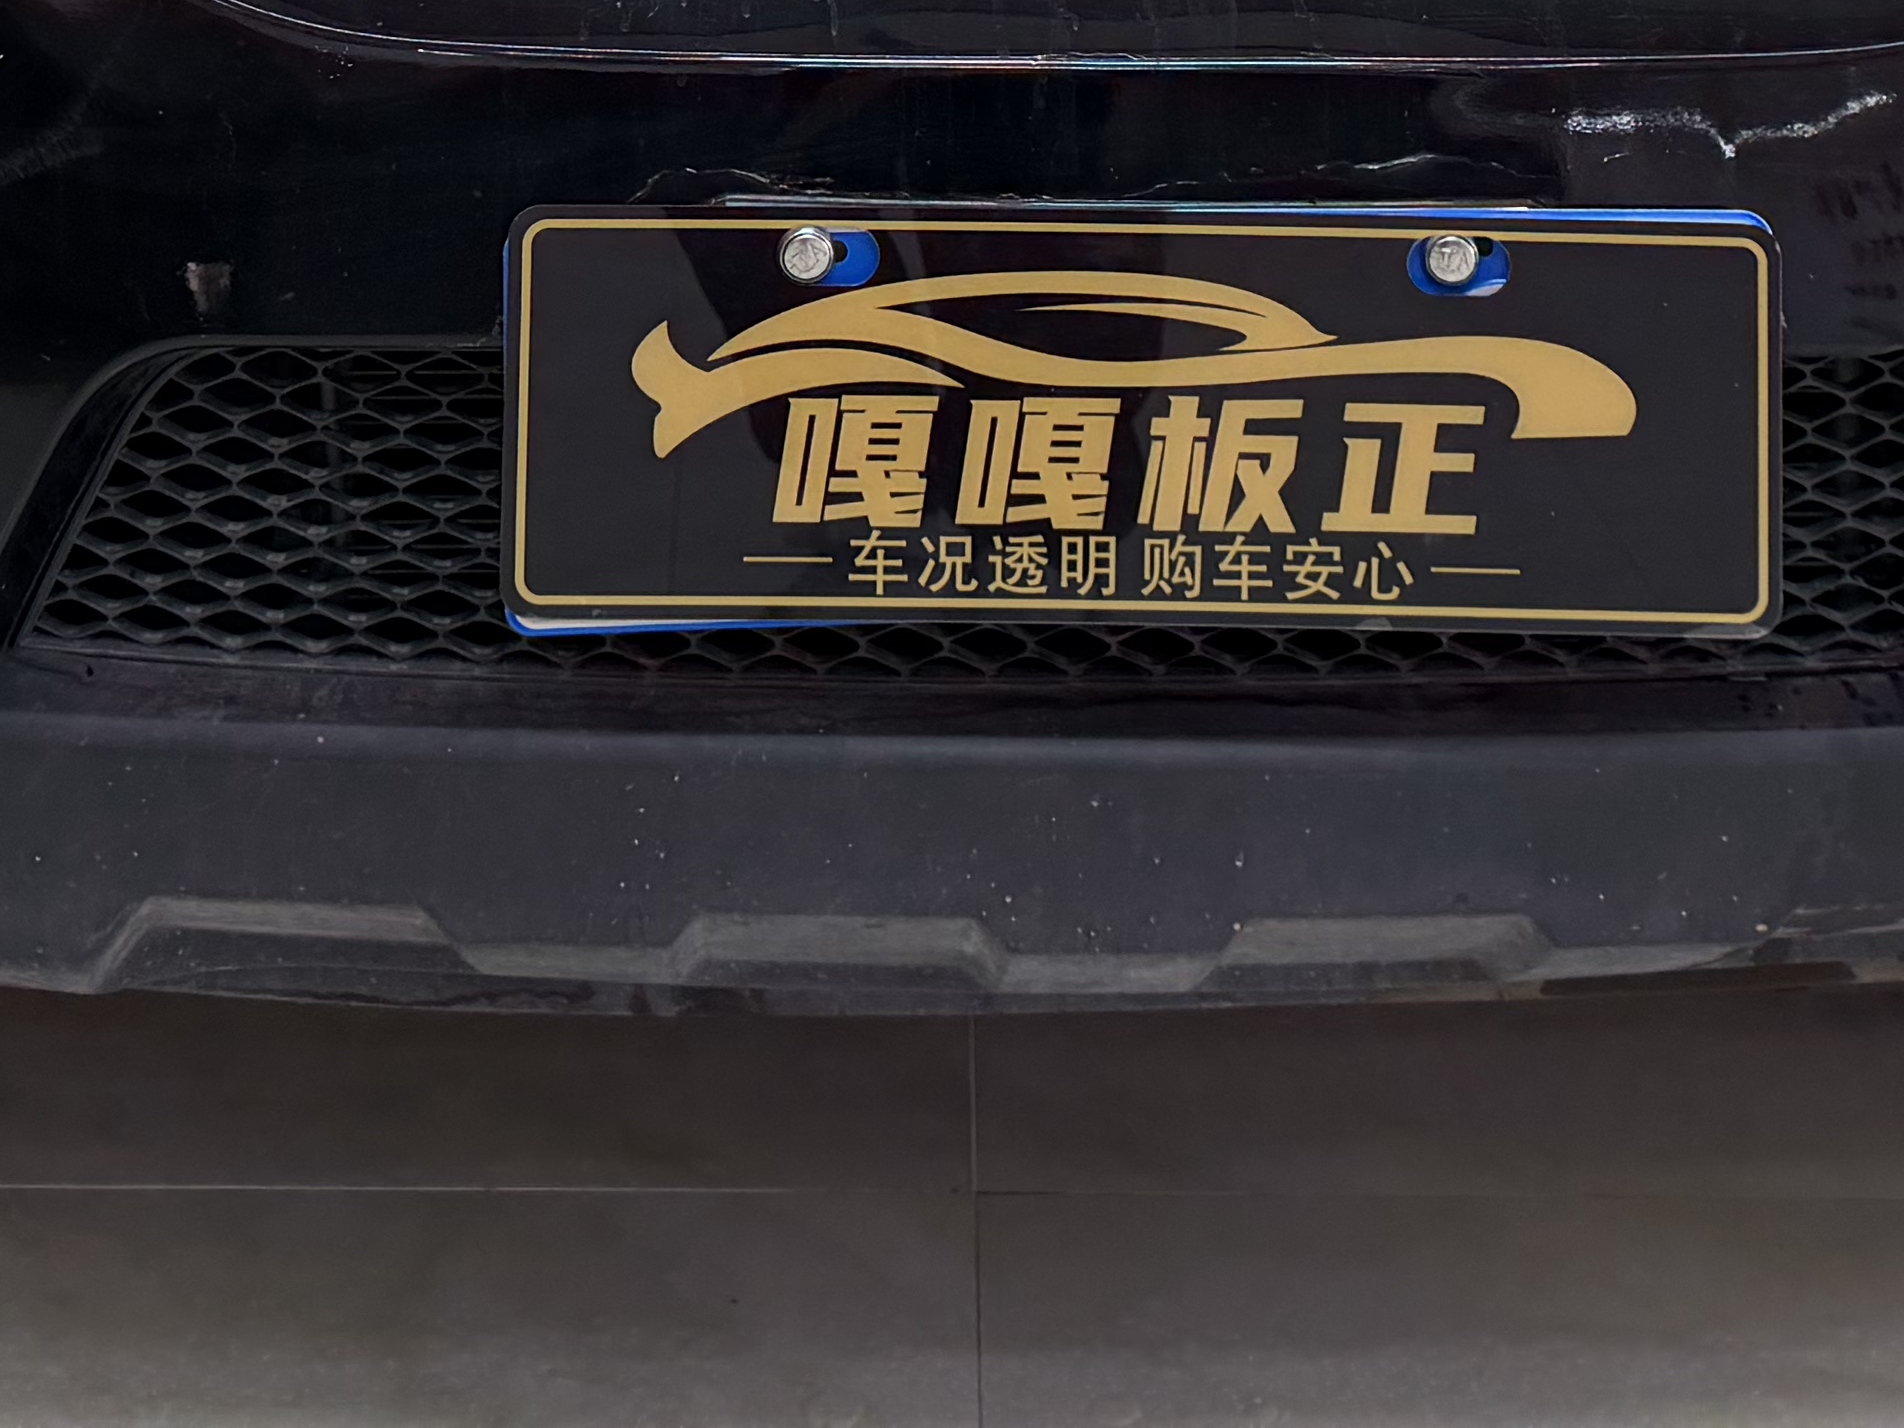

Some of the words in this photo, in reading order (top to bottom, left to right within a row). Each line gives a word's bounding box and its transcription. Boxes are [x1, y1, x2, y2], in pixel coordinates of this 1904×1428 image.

[772, 394, 1486, 535] 嘎嘎板正
[847, 529, 1119, 598] 车况透明
[1140, 533, 1415, 601] 购车安心
